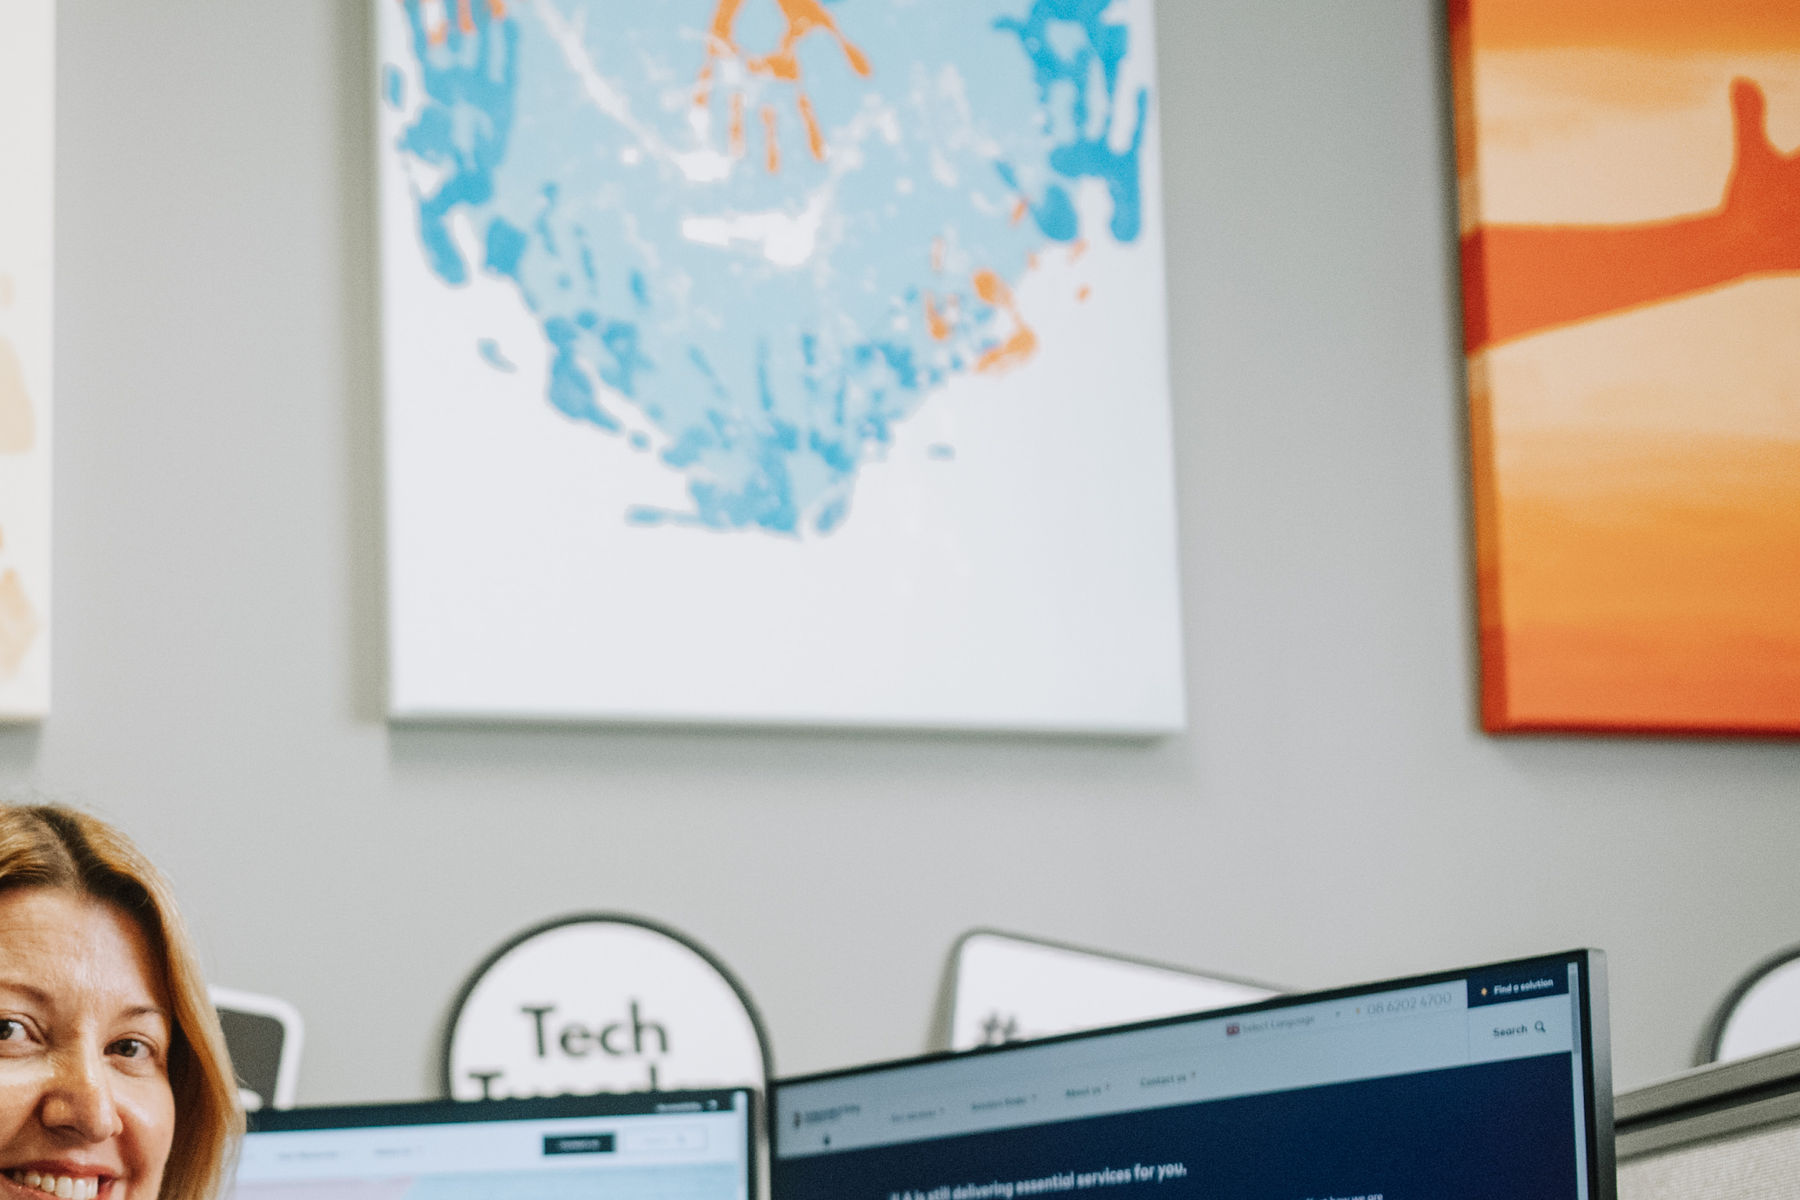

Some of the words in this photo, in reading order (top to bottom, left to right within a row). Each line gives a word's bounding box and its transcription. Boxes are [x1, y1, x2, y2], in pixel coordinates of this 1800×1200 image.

[1493, 982, 1512, 995] Find
[1520, 978, 1554, 991] solution
[1367, 1001, 1384, 1016] 08
[1386, 997, 1418, 1012] 6202
[1420, 991, 1453, 1008] 4700
[520, 997, 668, 1058] Tech
[1493, 1023, 1528, 1037] Search
[952, 1180, 1014, 1200] delivering
[1015, 1170, 1074, 1195] essential
[1076, 1166, 1131, 1188] services
[1133, 1162, 1155, 1182] for
